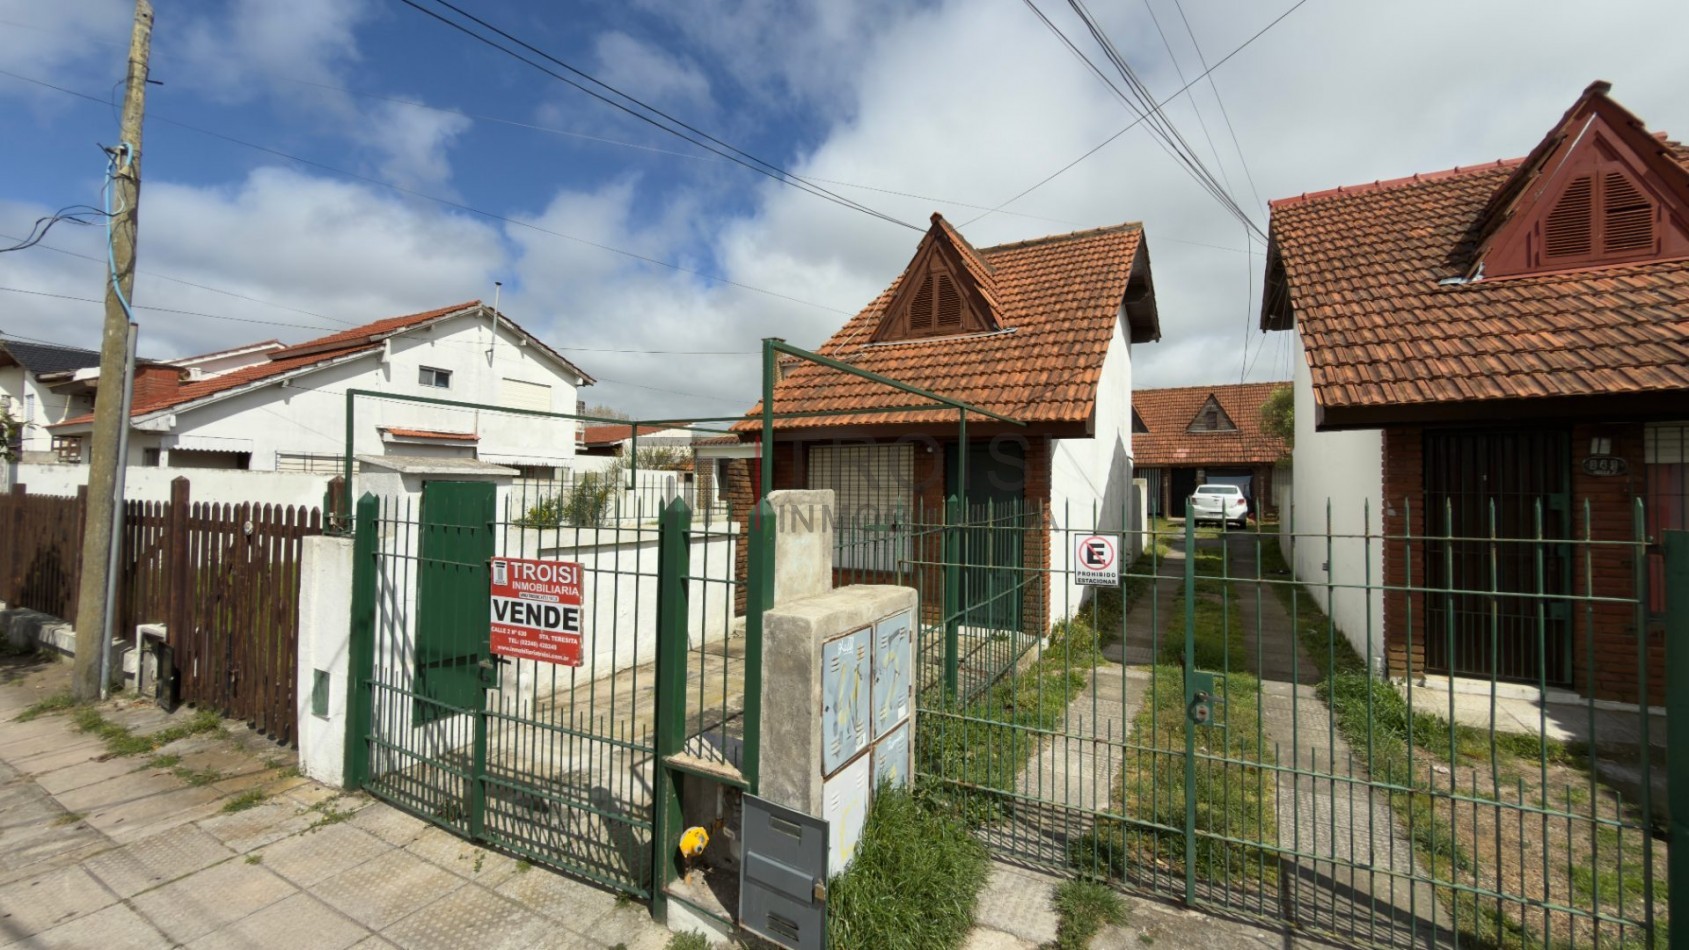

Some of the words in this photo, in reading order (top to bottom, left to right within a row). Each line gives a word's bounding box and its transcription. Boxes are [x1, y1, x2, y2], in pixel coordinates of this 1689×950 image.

[1087, 543, 1106, 564] E
[510, 562, 577, 585] TROISI
[512, 581, 580, 596] INMOBILIARIA
[492, 599, 579, 632] VENDE
[491, 626, 506, 634] CALLE
[551, 635, 578, 645] TERESITA
